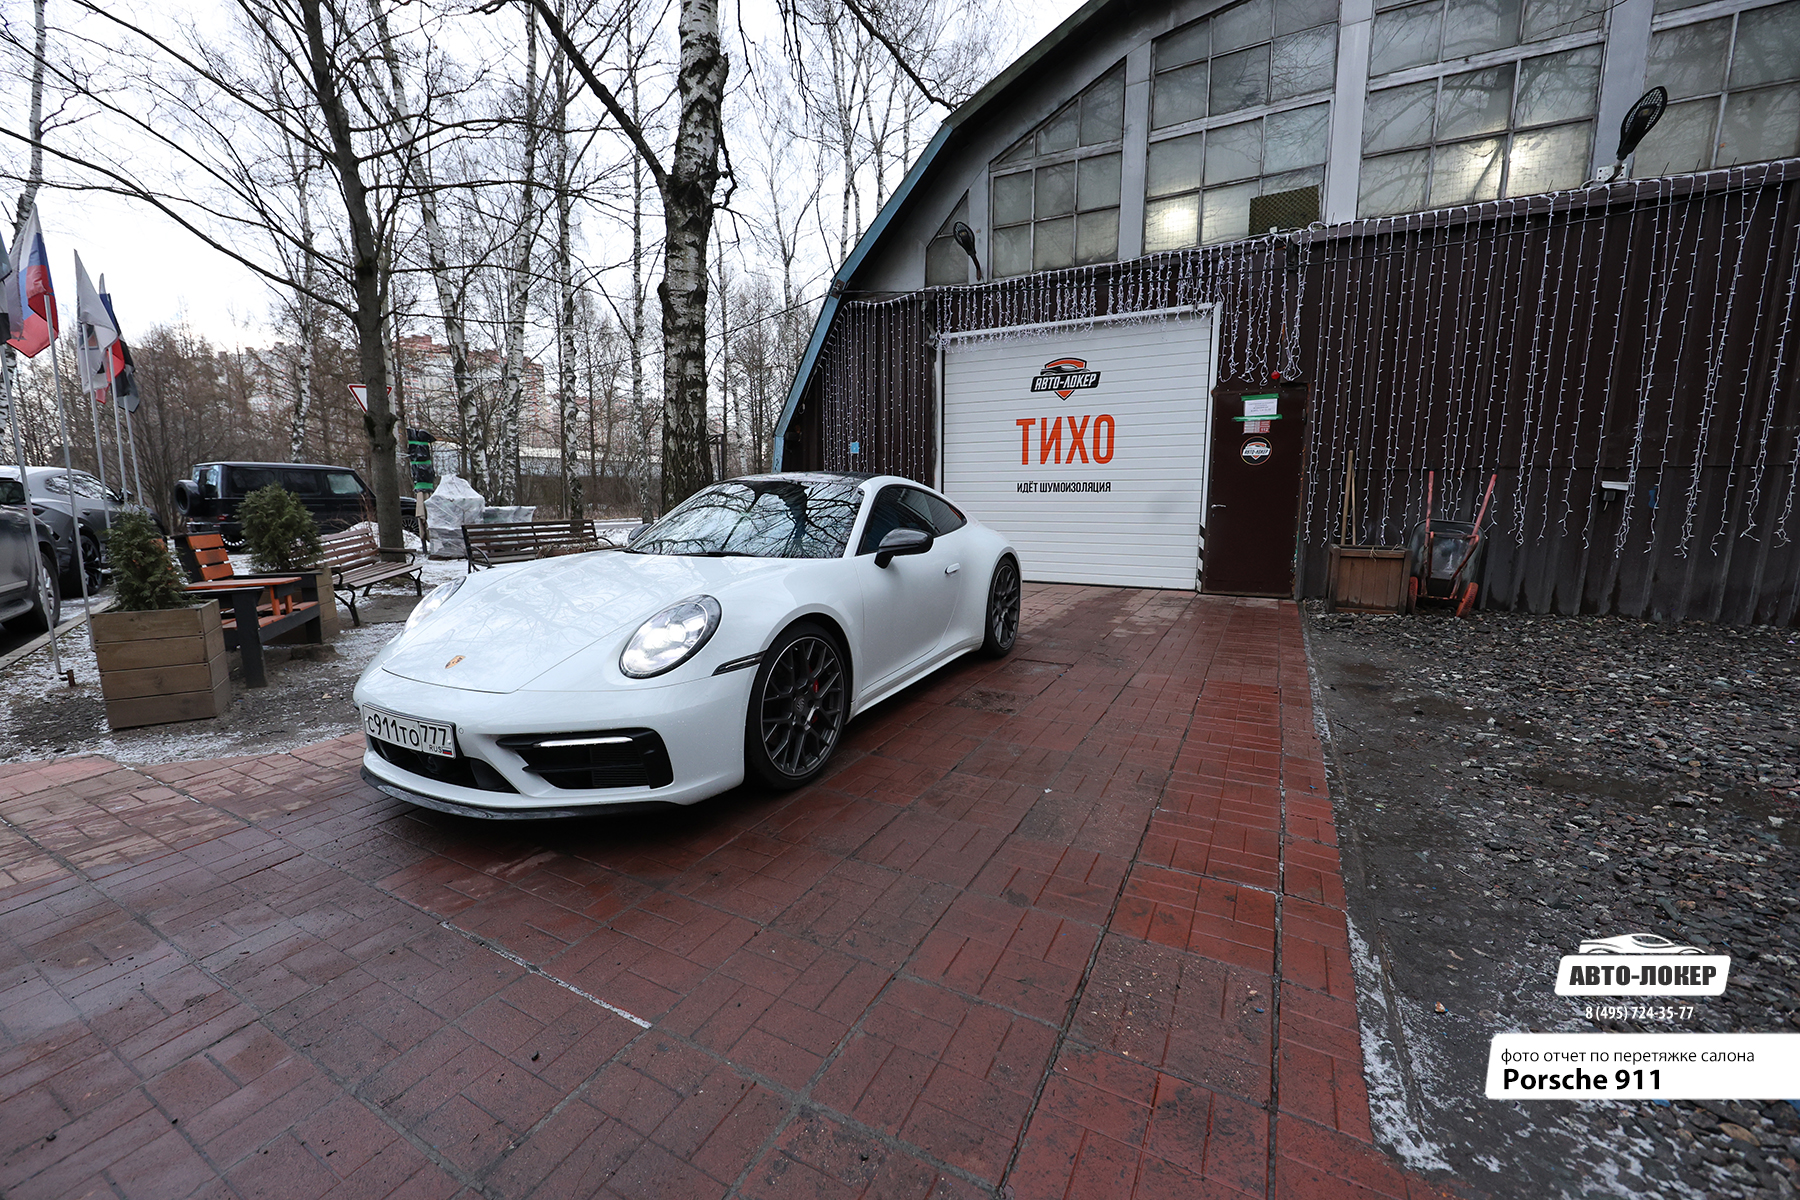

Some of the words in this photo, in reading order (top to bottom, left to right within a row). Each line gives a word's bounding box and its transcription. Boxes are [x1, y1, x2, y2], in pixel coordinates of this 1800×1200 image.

[1034, 373, 1097, 391] АВТО-ЛОКЕР
[1016, 414, 1115, 466] ТИХО
[1016, 481, 1038, 493] ИДЁТ
[1039, 481, 1111, 493] ШУМОИЗОЛЯЦИЯ
[428, 744, 443, 754] RUS
